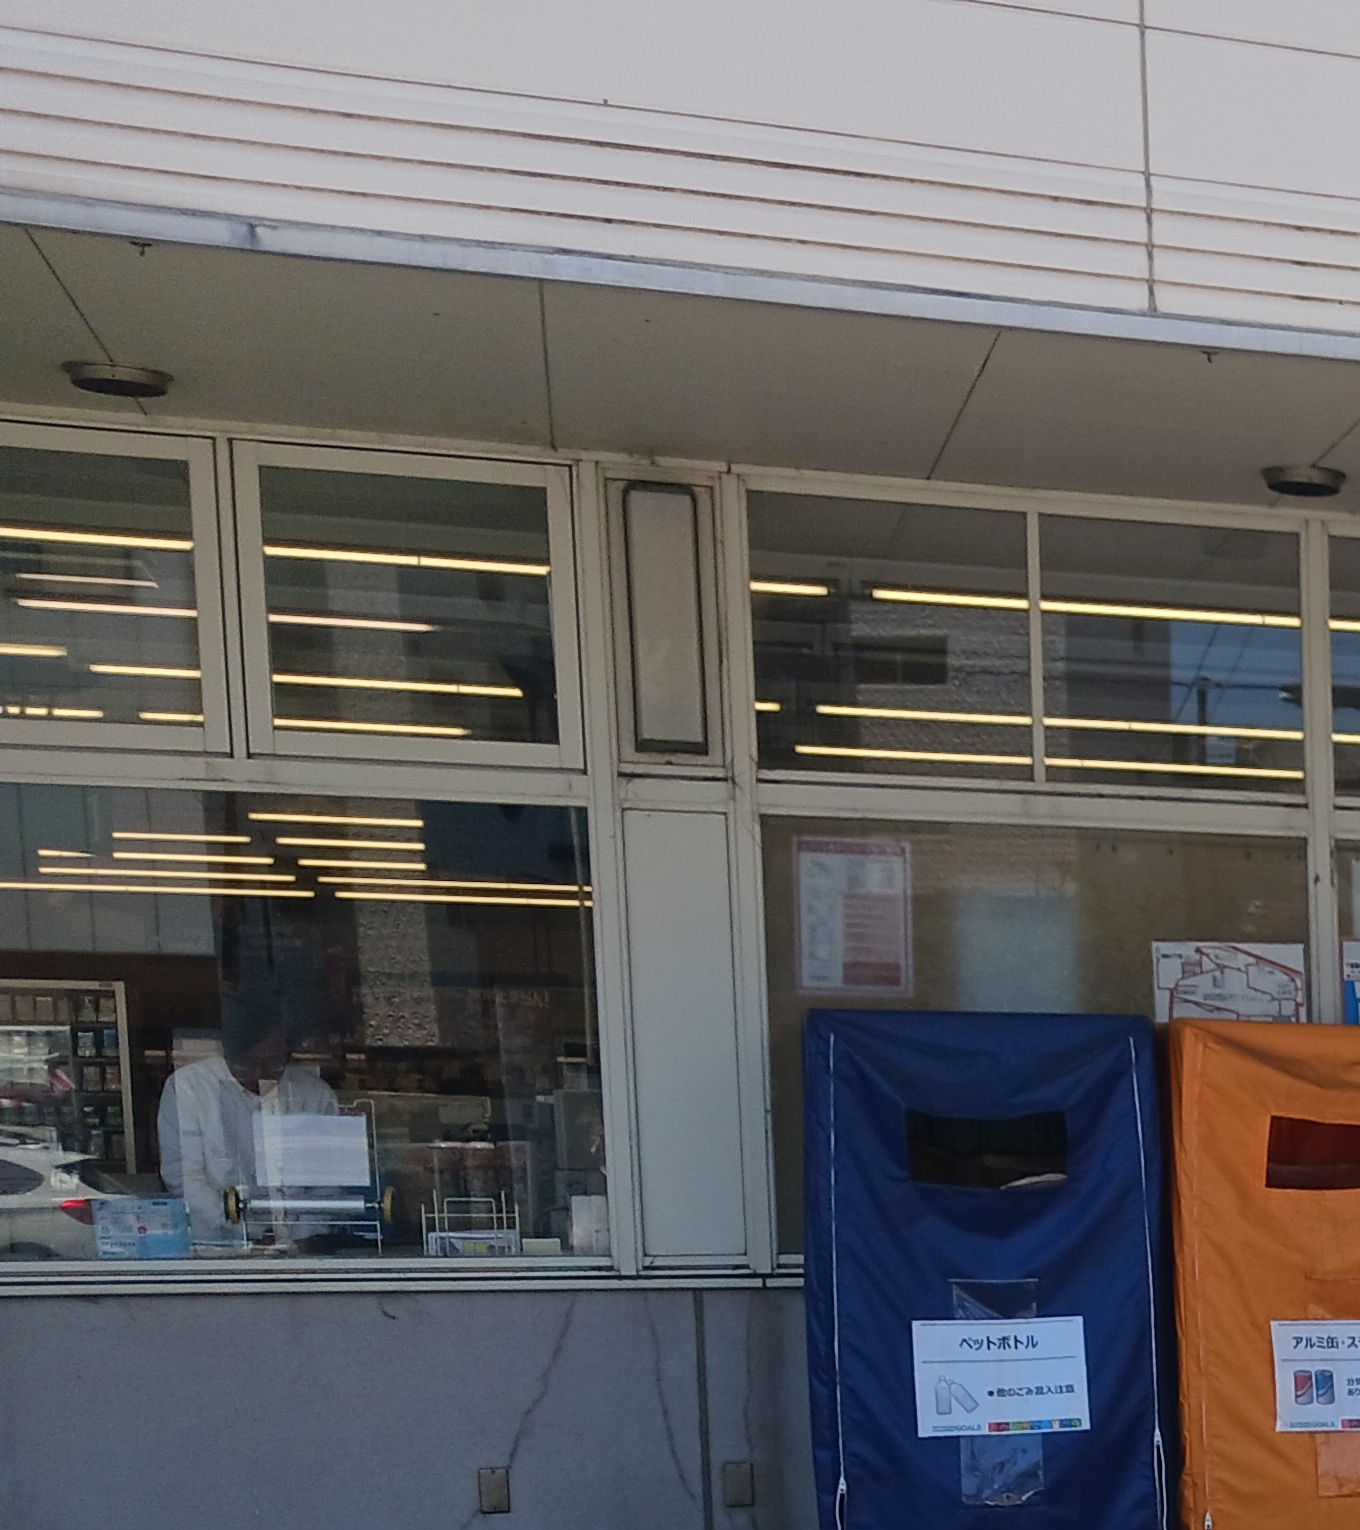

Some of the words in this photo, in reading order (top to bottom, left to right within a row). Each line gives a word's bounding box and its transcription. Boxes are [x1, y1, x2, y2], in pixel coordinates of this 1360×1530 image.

[958, 1334, 1039, 1351] ペットボトル
